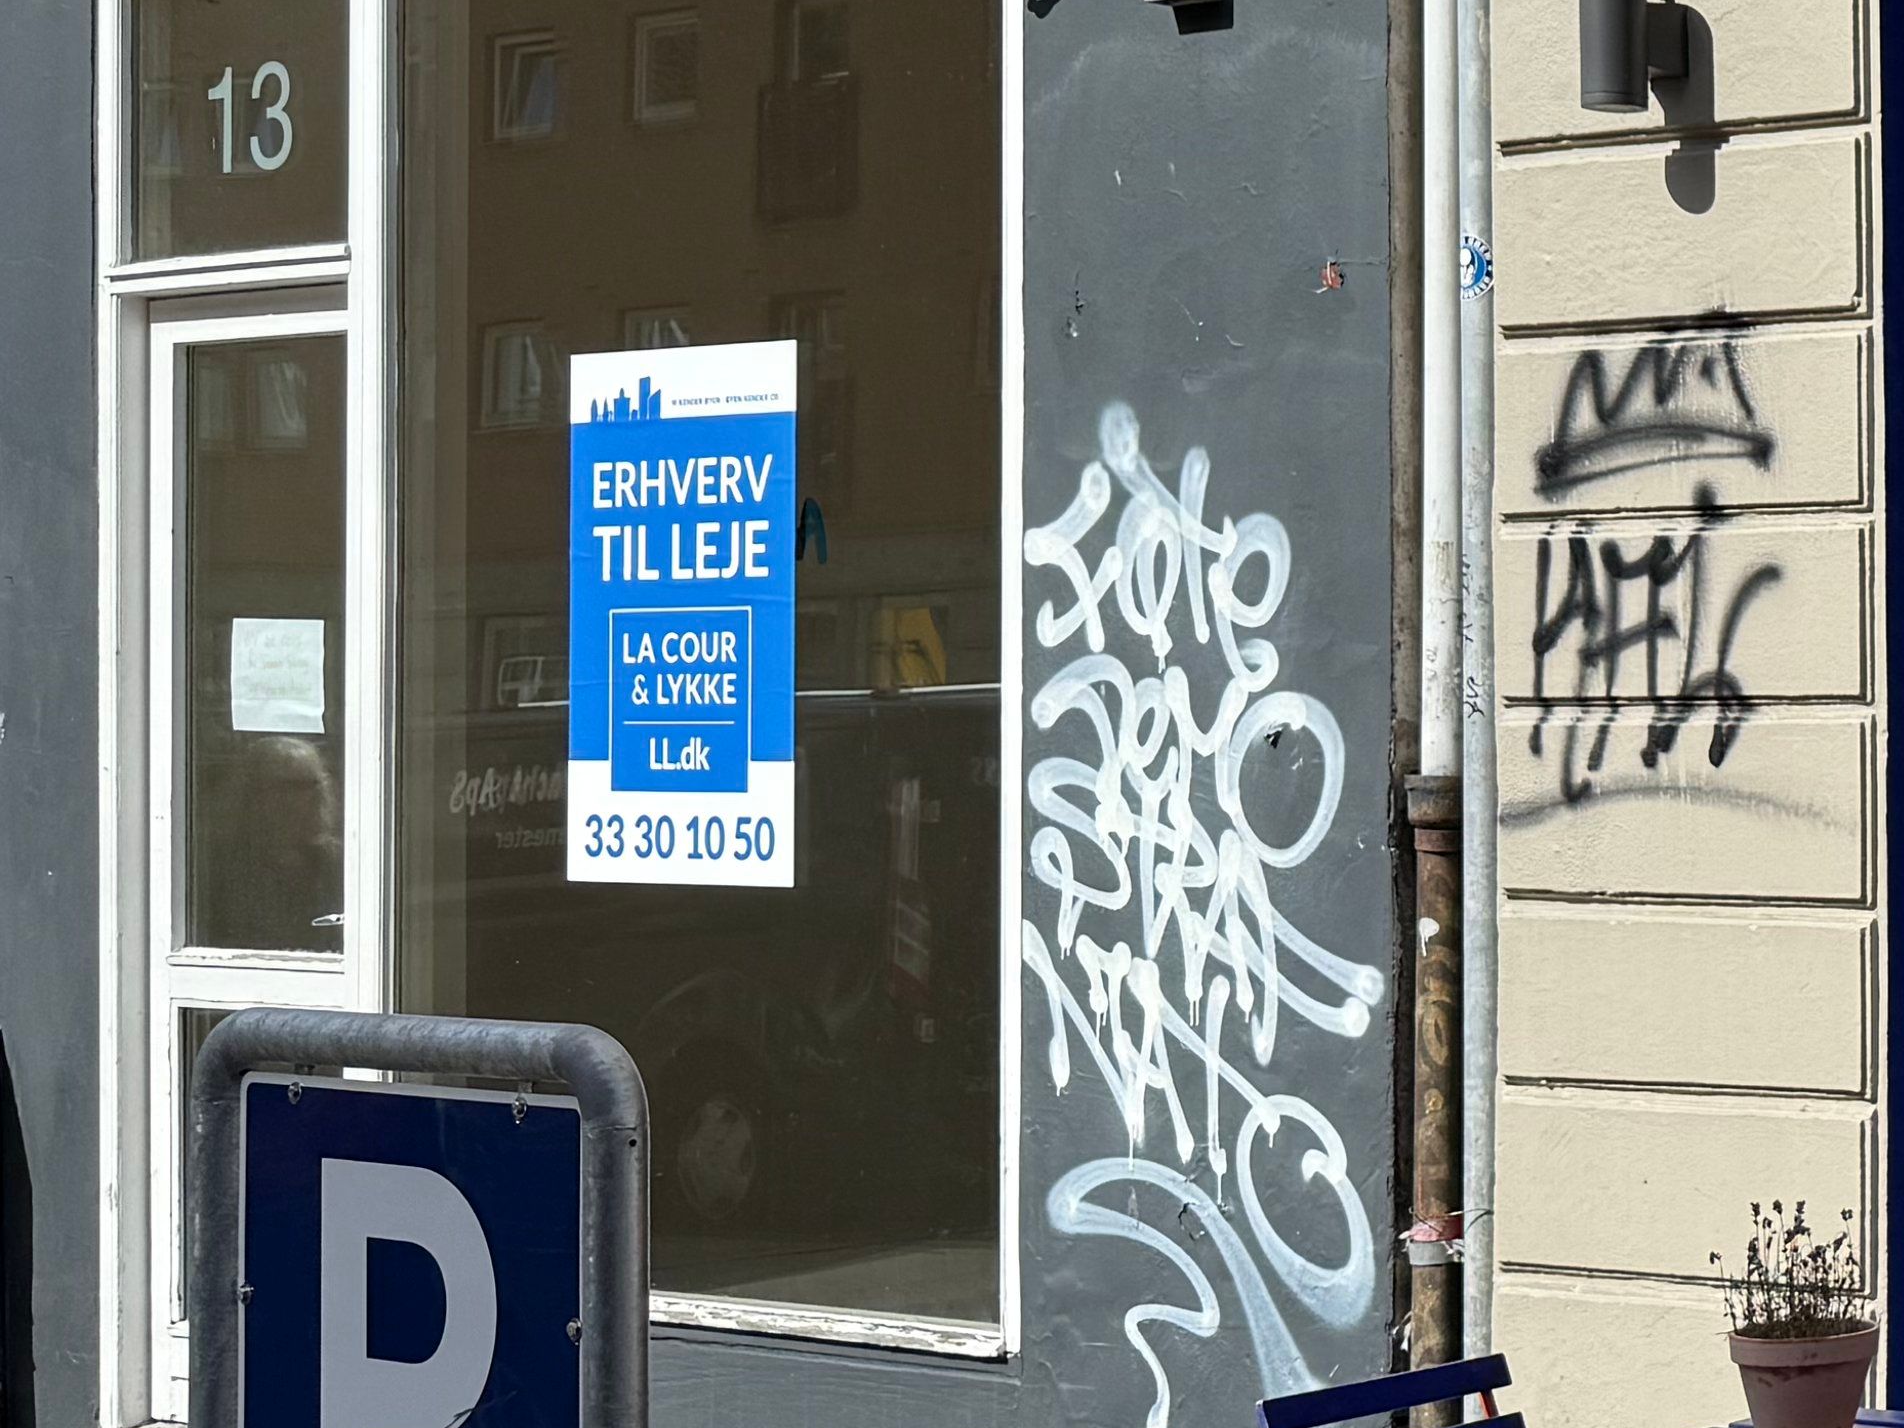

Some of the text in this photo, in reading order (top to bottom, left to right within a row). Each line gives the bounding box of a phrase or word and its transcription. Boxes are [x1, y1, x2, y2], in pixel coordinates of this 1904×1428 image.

[208, 61, 293, 174] 13
[593, 453, 773, 509] ERHVERV
[593, 524, 660, 582] TIL
[671, 521, 770, 580] LEJE
[622, 630, 737, 664] LA COUR
[631, 673, 737, 706] & LYKKE
[648, 736, 710, 771] LL.dk
[584, 813, 775, 862] 33 30 10 50
